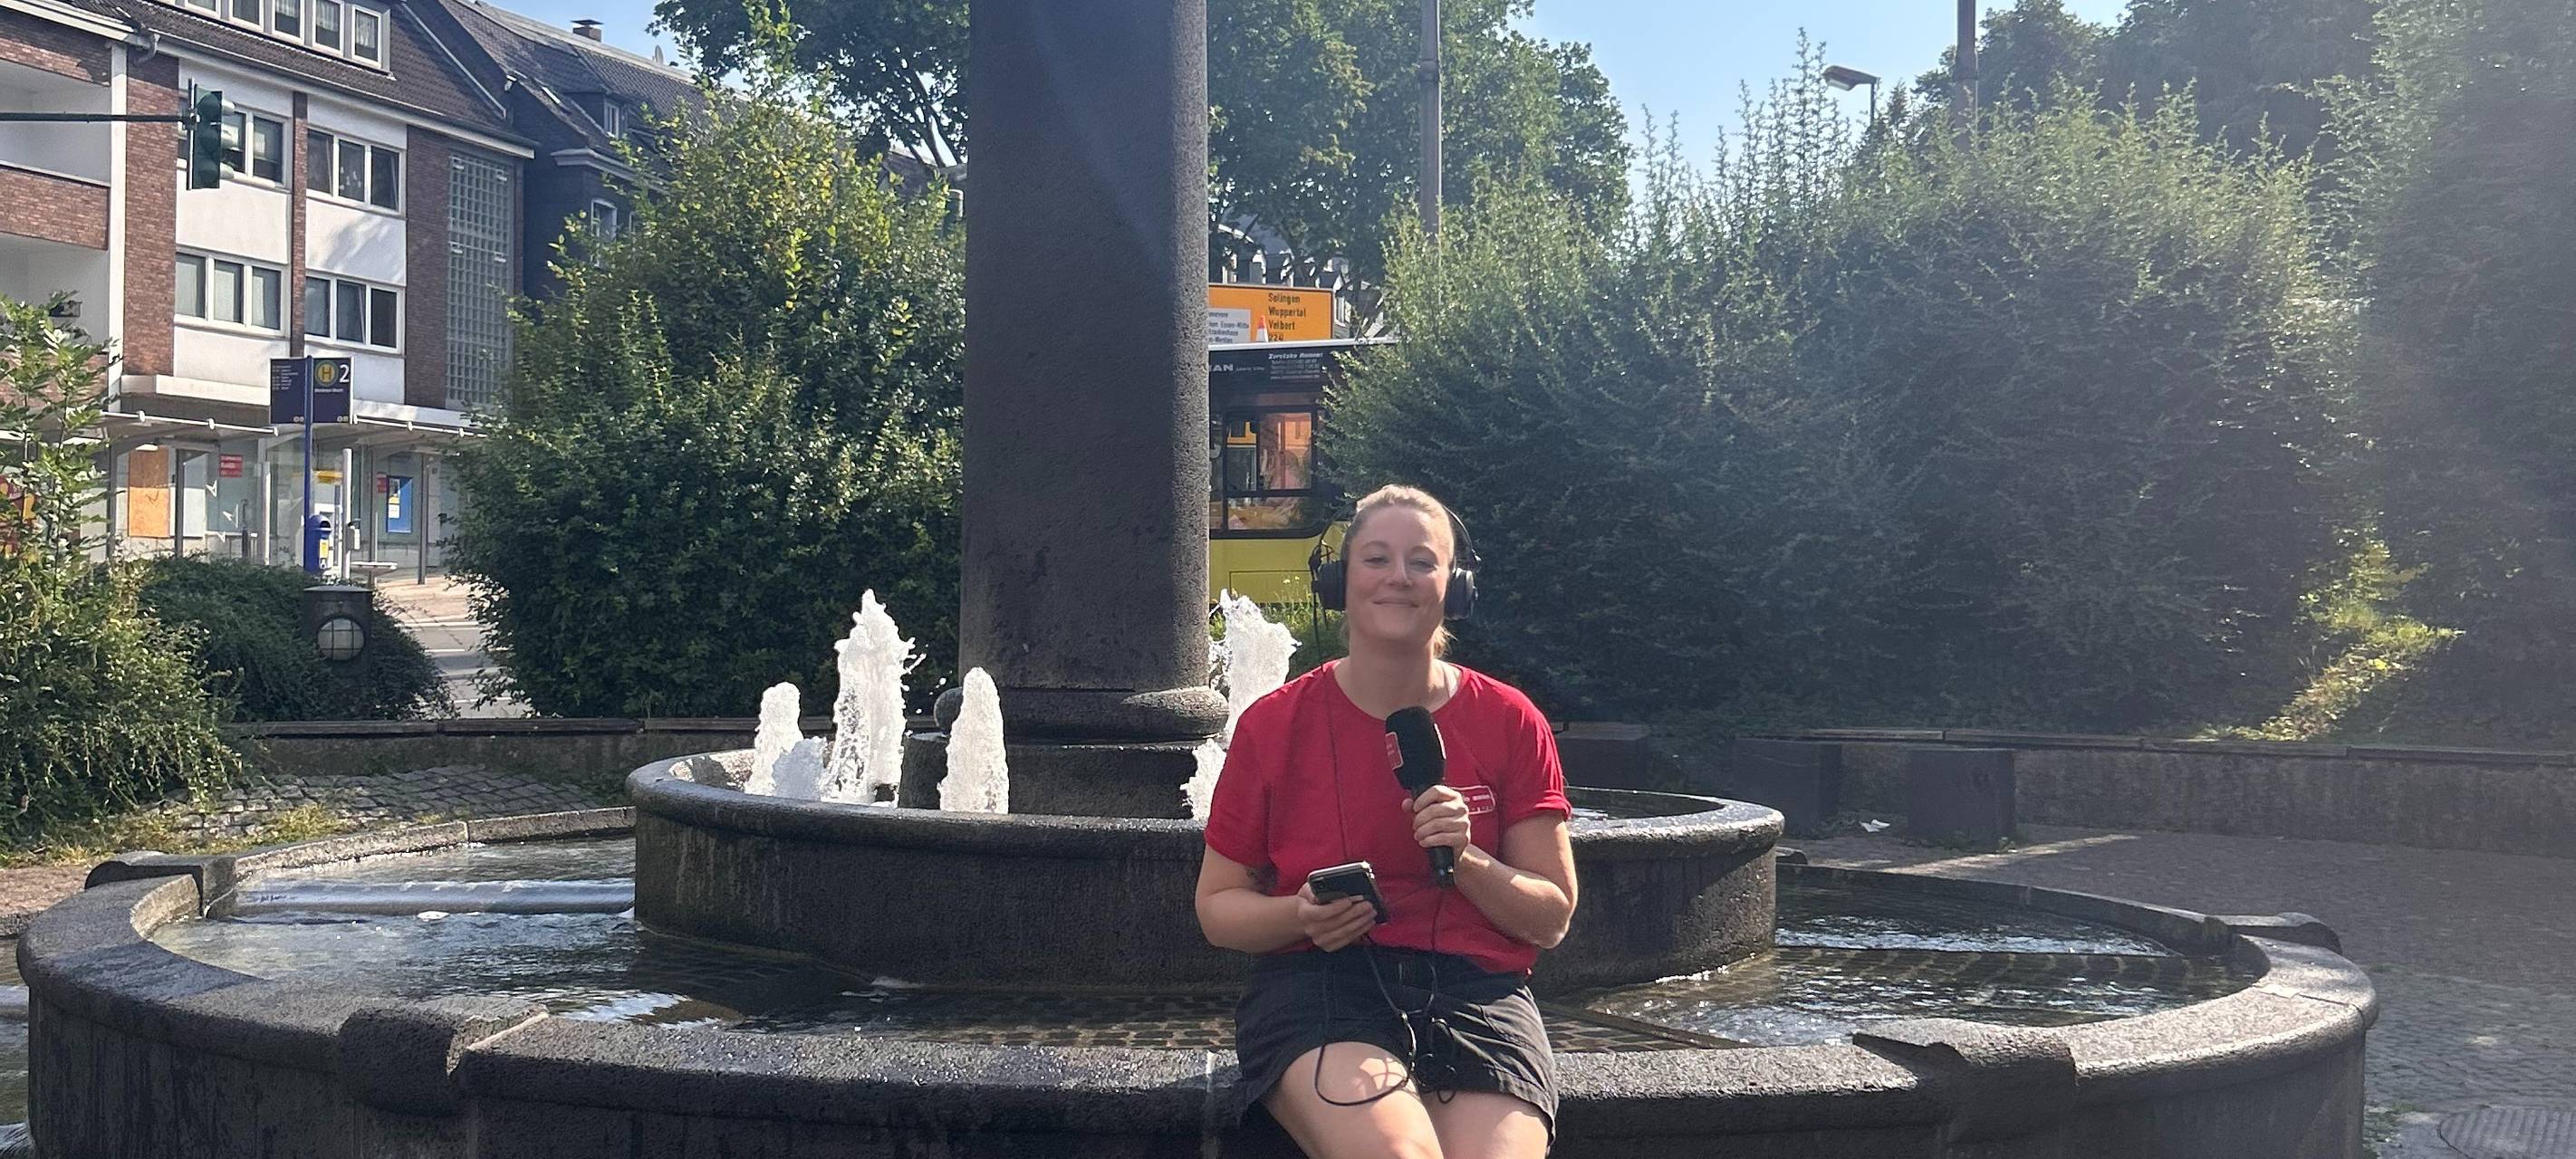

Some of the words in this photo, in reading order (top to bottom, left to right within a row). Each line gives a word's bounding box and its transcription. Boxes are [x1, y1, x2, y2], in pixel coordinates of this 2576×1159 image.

[1268, 292, 1301, 304] Solingen
[1268, 306, 1306, 318] Wuppertal
[1268, 320, 1295, 330] Velbert
[322, 367, 332, 380] H
[340, 364, 350, 383] 2
